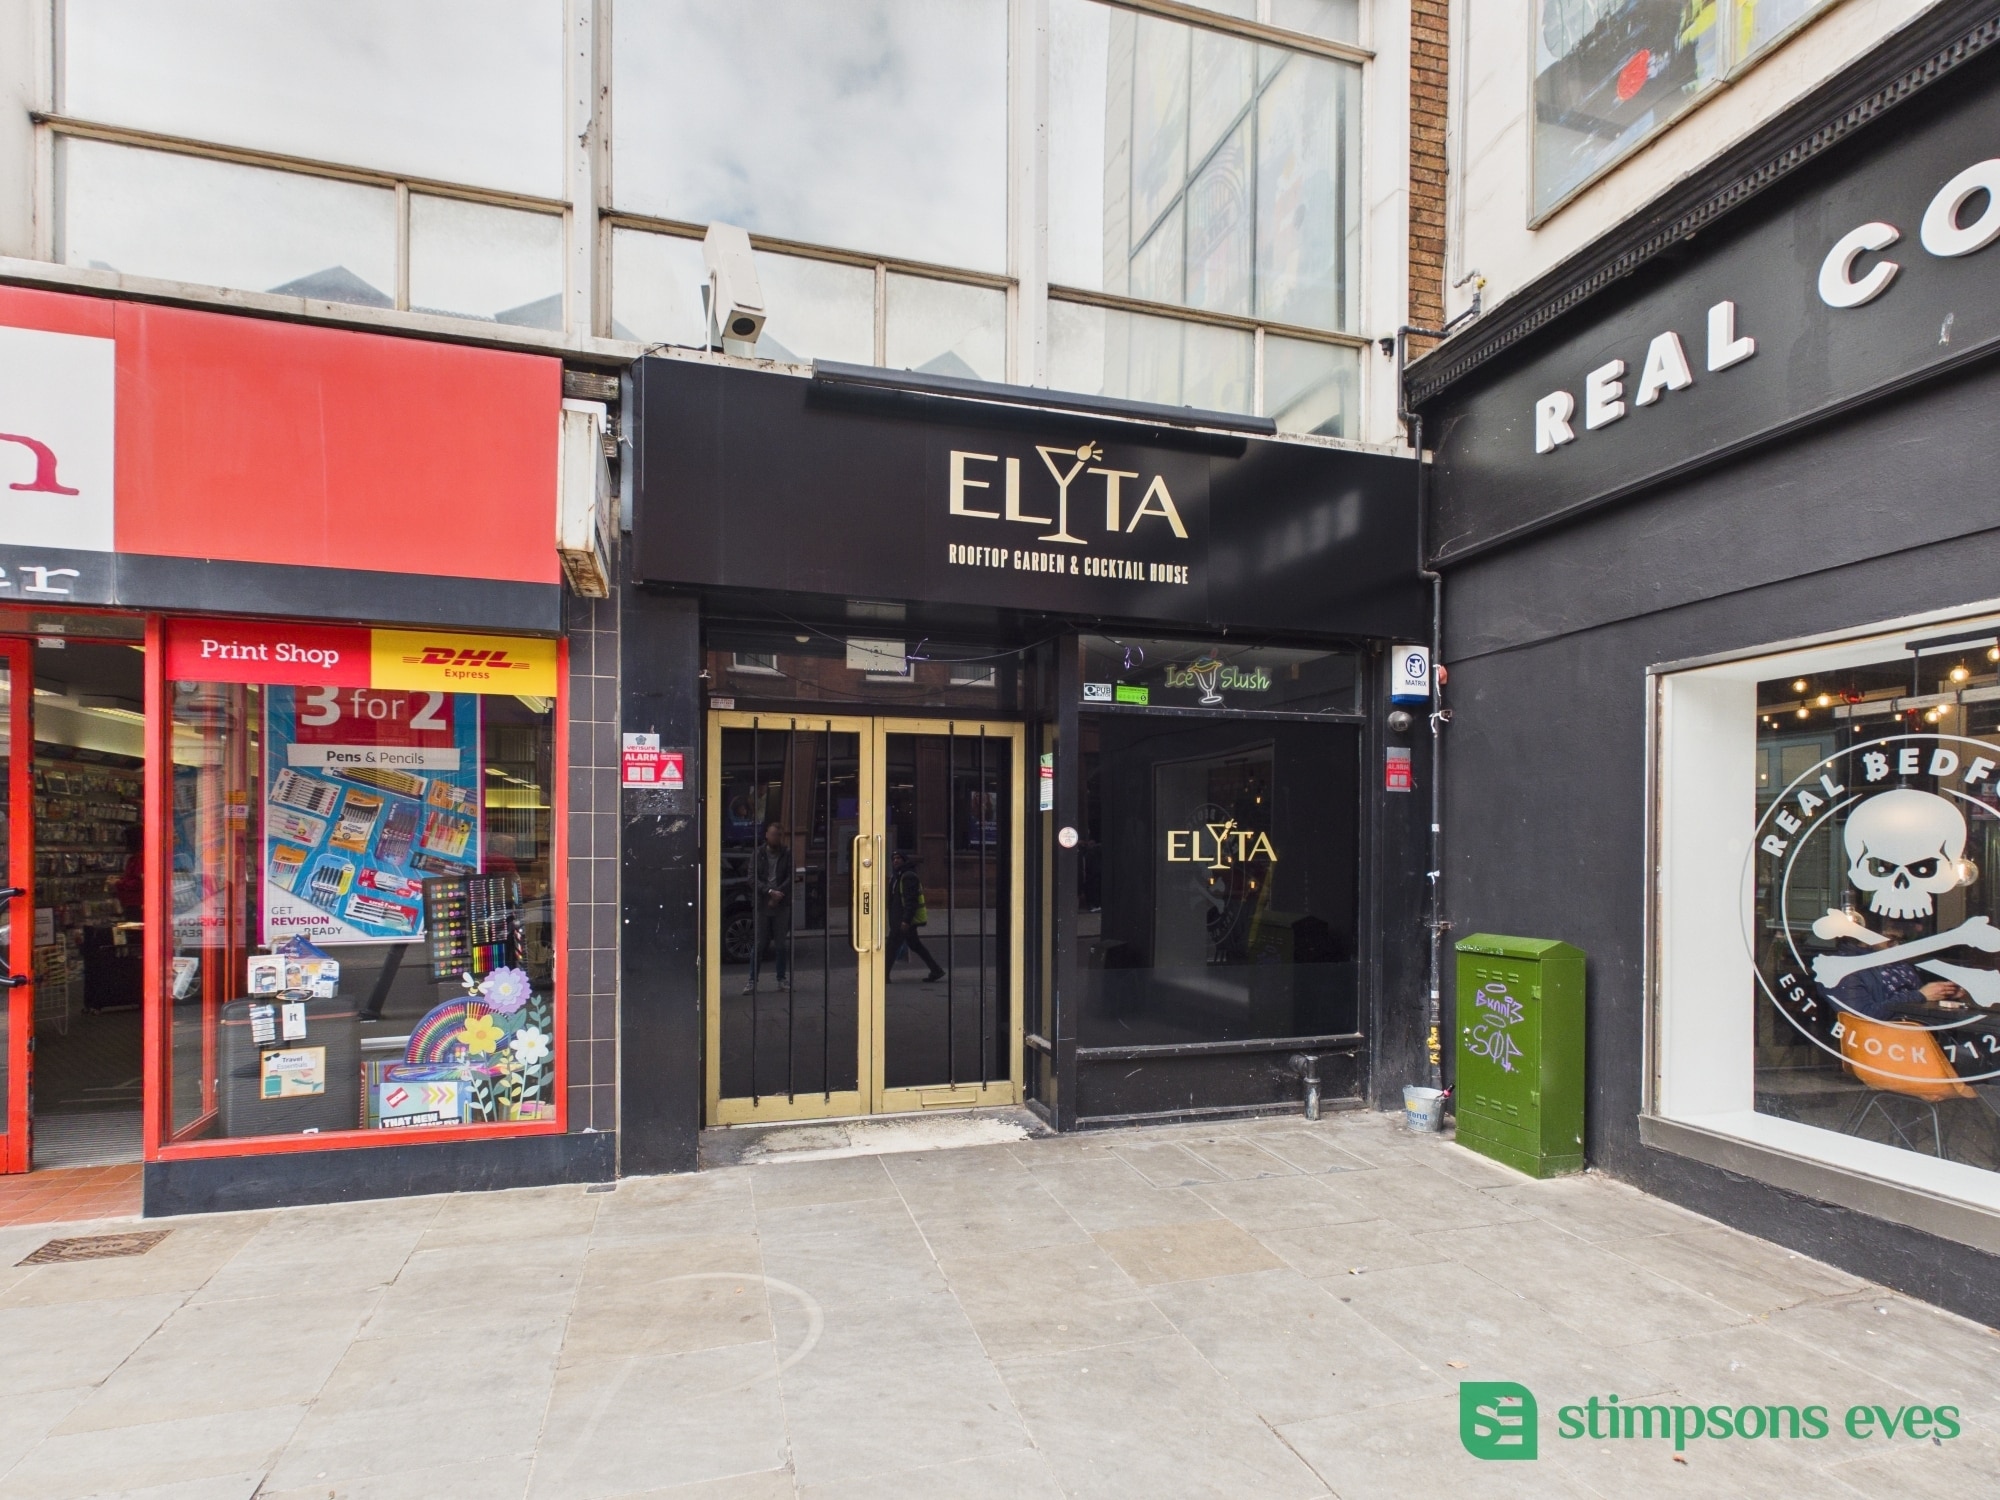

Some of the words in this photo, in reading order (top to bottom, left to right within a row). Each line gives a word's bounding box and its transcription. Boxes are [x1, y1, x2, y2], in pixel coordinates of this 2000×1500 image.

[1535, 300, 1755, 454] REAL
[950, 441, 1189, 545] ELYTA
[949, 543, 1008, 569] ROOFTOP
[1014, 551, 1065, 574] GARDEN
[1070, 558, 1079, 575] &
[1084, 557, 1145, 581] COCKTAIL
[1150, 563, 1189, 585] HOUSE
[200, 639, 268, 662] Print
[275, 643, 340, 669] Shop
[419, 646, 516, 669] DHL
[444, 668, 490, 680] Express
[1165, 664, 1196, 687] Ice
[1220, 665, 1271, 692] Slush
[1405, 679, 1427, 688] MATRIX
[300, 685, 341, 727] 3
[350, 688, 405, 720] for
[409, 691, 447, 731] 2
[326, 750, 361, 763] Pens
[365, 751, 377, 763] &
[379, 752, 425, 765] Pencils
[624, 753, 659, 762] ALARM
[1761, 773, 1845, 858] REAL
[1167, 818, 1278, 870] ELYTA
[271, 906, 294, 915] GET
[271, 916, 330, 926] REVISION
[1779, 973, 1817, 1022] EST.
[1830, 1021, 1929, 1065] BLOCK
[382, 1116, 412, 1128] THAT
[413, 1112, 438, 1124] NEW
